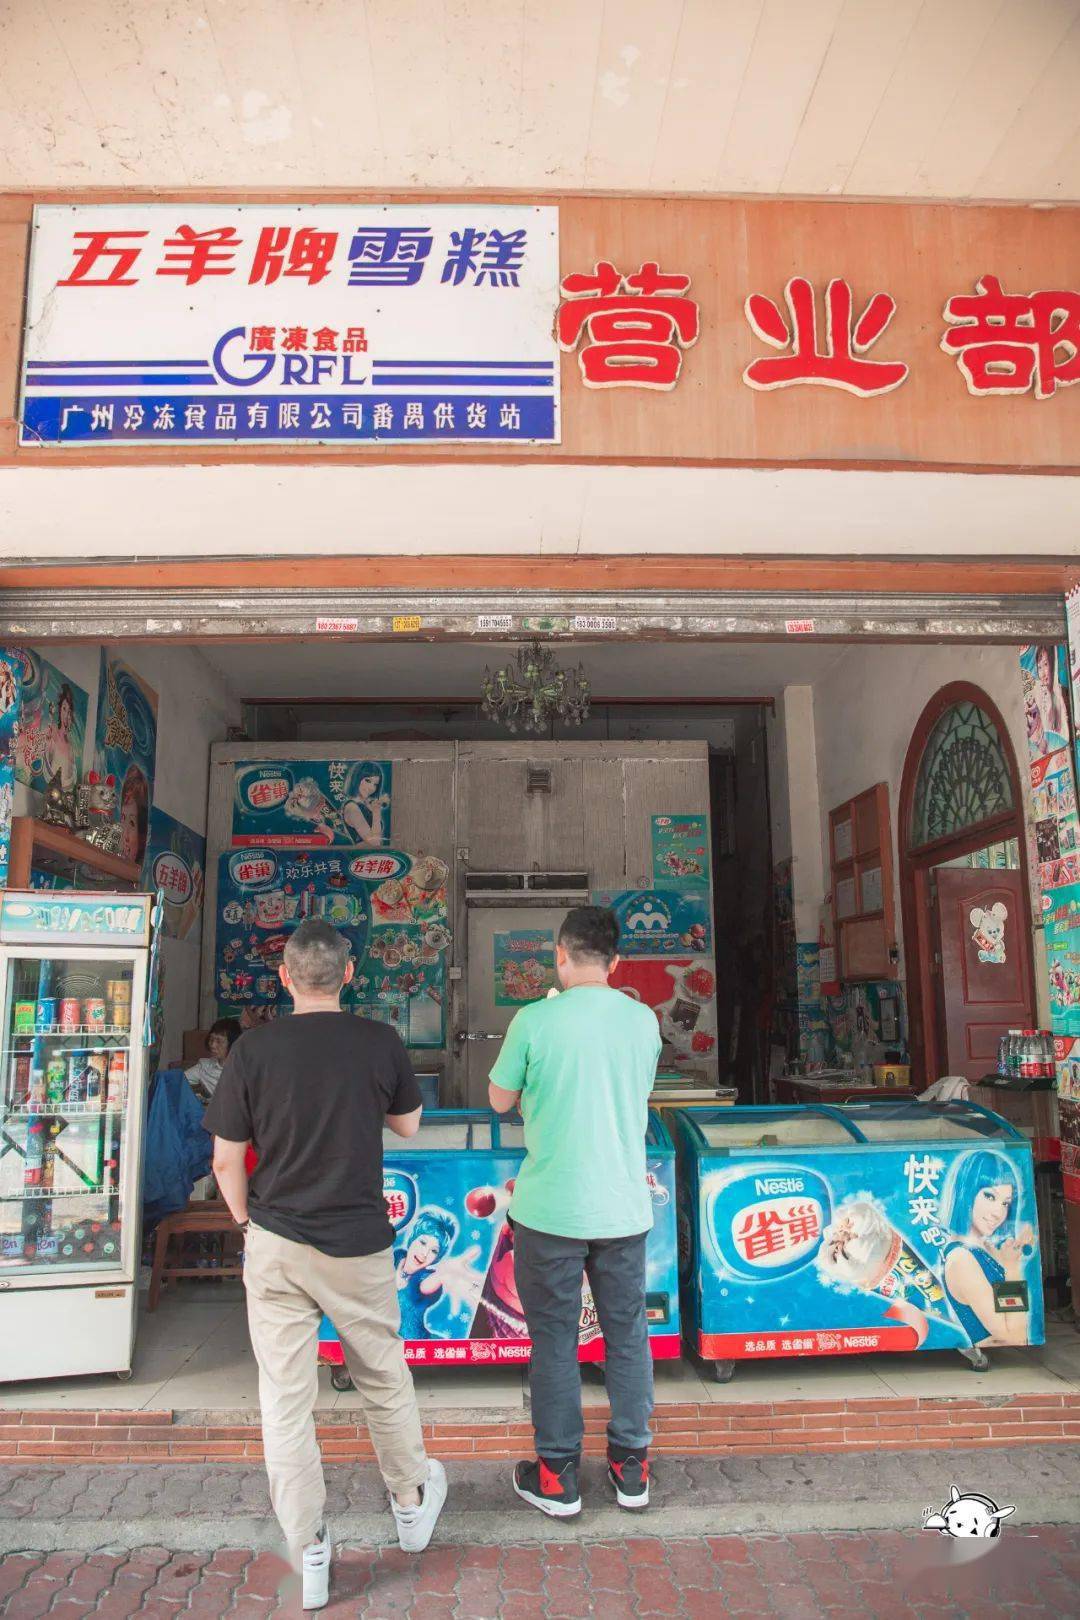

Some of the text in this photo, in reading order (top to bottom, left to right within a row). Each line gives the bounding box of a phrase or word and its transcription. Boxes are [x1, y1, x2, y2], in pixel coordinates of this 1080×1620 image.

[57, 224, 528, 288] 五羊牌雪糕
[249, 326, 369, 353] 廣凍食品
[556, 261, 1080, 400] 营业部
[212, 326, 368, 387] GRFL
[60, 401, 522, 431] 广州冷冻食品有限公司番禺供货站
[250, 781, 289, 806] 雀巢
[159, 864, 188, 894] 五羊牌
[239, 861, 272, 881] 雀巢
[285, 859, 342, 880] 欢乐共享
[354, 859, 395, 875] 五羊牌
[738, 1204, 820, 1260] 雀巢
[745, 1339, 776, 1352] 选品质
